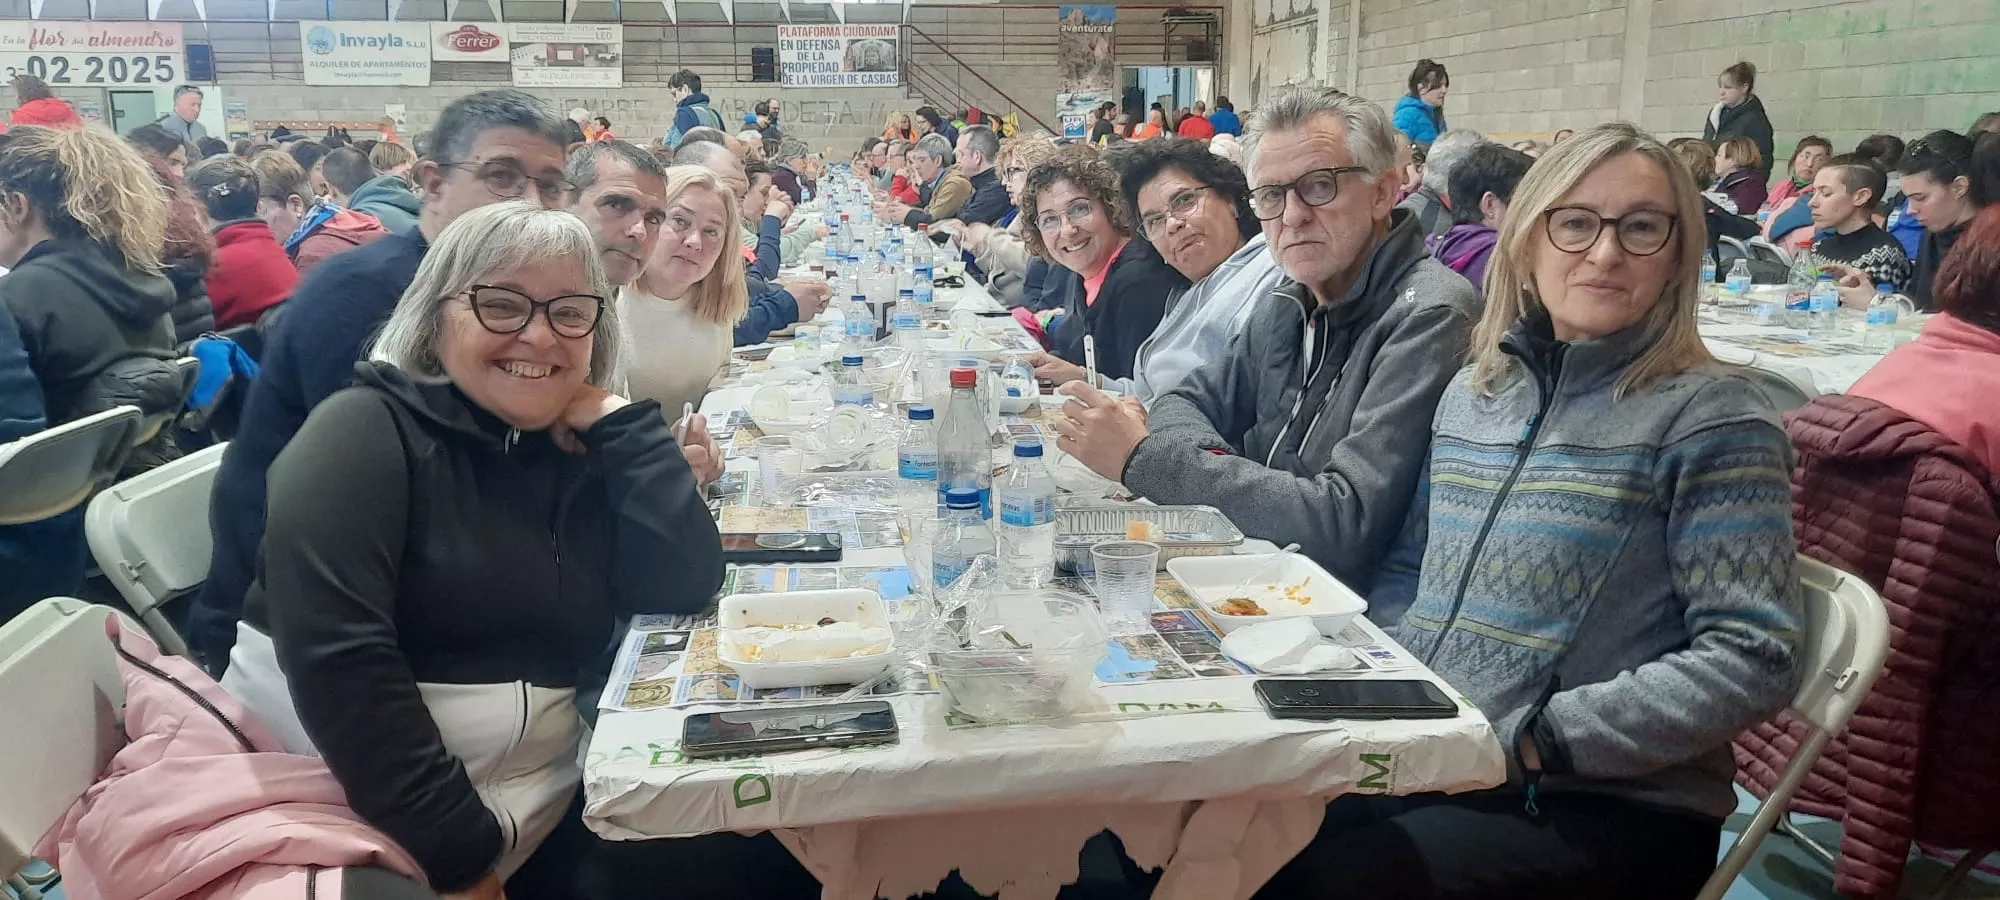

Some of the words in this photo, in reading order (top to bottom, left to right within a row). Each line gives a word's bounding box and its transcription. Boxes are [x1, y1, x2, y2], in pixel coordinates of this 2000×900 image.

[780, 26, 840, 37] PLATAFORMA
[843, 26, 897, 37] CIUDADANA
[1060, 24, 1113, 33] aventúrate
[29, 28, 66, 50] flor
[88, 30, 175, 47] almendro
[447, 34, 494, 48] Ferrer
[781, 40, 793, 50] EN
[797, 40, 840, 51] DEFENSA
[797, 52, 810, 61] DE
[813, 51, 825, 61] LA
[310, 60, 348, 68] ALQUILER
[363, 61, 427, 69] APARTAMENTOS
[781, 62, 839, 73] PROPIEDAD
[782, 75, 794, 85] DE
[797, 74, 808, 85] LA
[811, 74, 844, 85] VIRGEN
[847, 74, 859, 84] DE
[861, 73, 898, 84] CASBAS
